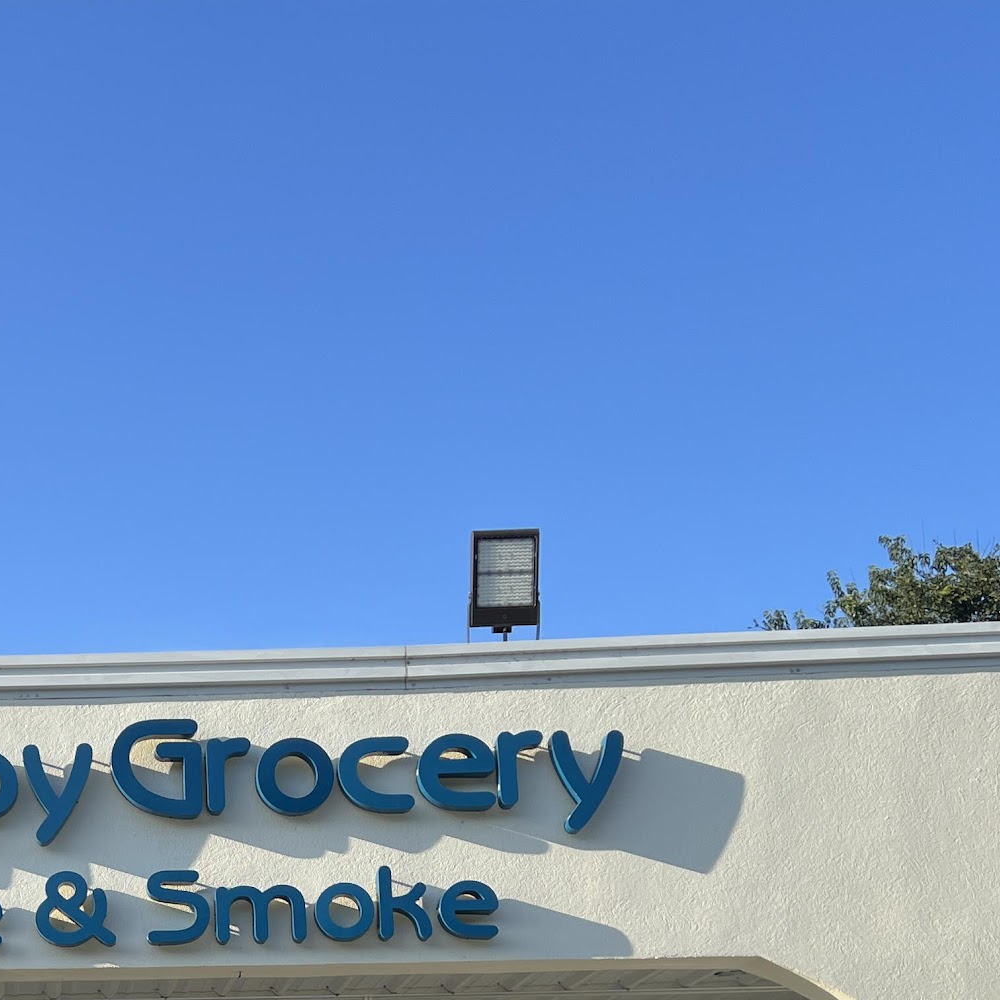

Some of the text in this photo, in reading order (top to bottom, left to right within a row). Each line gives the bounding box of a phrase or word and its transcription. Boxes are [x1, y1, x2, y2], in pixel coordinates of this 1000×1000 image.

[111, 718, 624, 835] Grocery
[35, 870, 117, 947] &
[146, 865, 500, 947] Smoke
